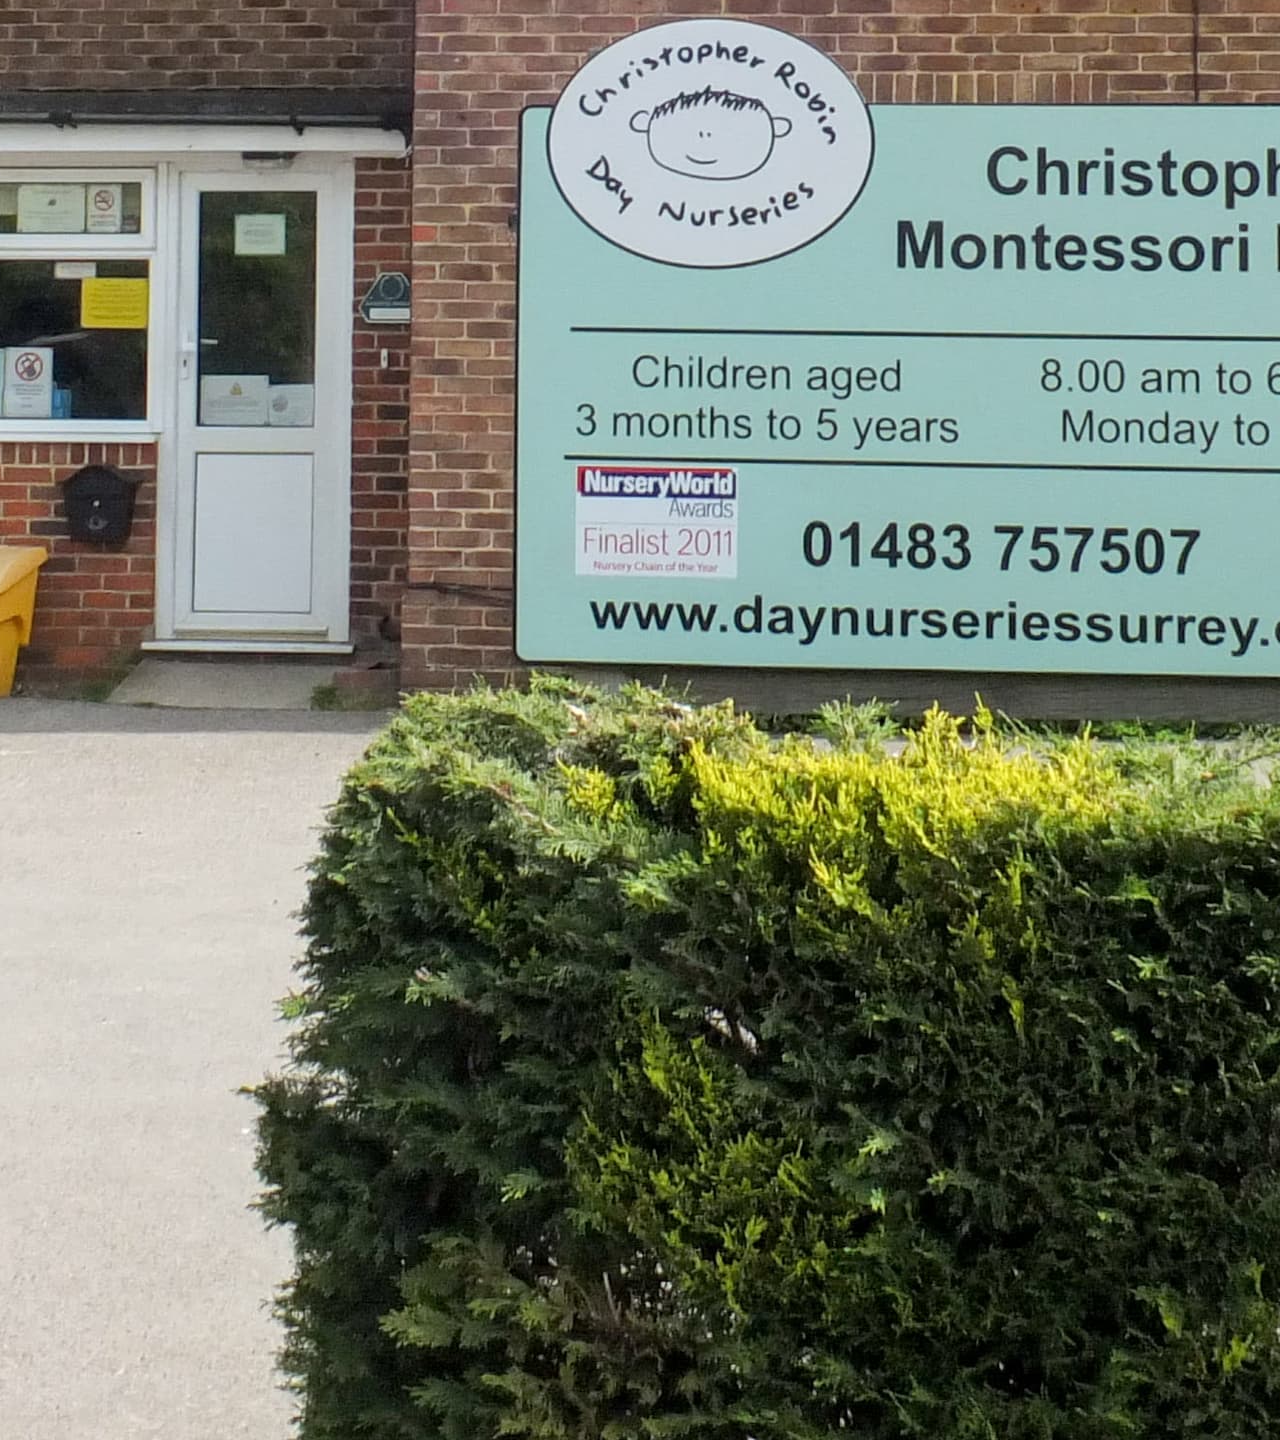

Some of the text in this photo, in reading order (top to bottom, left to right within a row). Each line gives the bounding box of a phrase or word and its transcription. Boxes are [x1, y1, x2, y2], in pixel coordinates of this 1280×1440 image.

[579, 41, 837, 145] Christopher Robin
[585, 155, 814, 227] Day Nurseries
[896, 220, 1249, 273] Montessori
[632, 354, 901, 401] Children aged
[1040, 358, 1125, 393] 8.00
[1140, 368, 1200, 394] am
[1215, 363, 1252, 395] to
[576, 403, 959, 451] 3 months to 5 years
[1062, 409, 1220, 455] Monday
[1233, 413, 1270, 446] to
[669, 498, 734, 518] Awards
[583, 527, 732, 557] Finalist 2011
[802, 520, 1201, 576] 01483 757507
[593, 560, 719, 573] Nursery Chain of the Year
